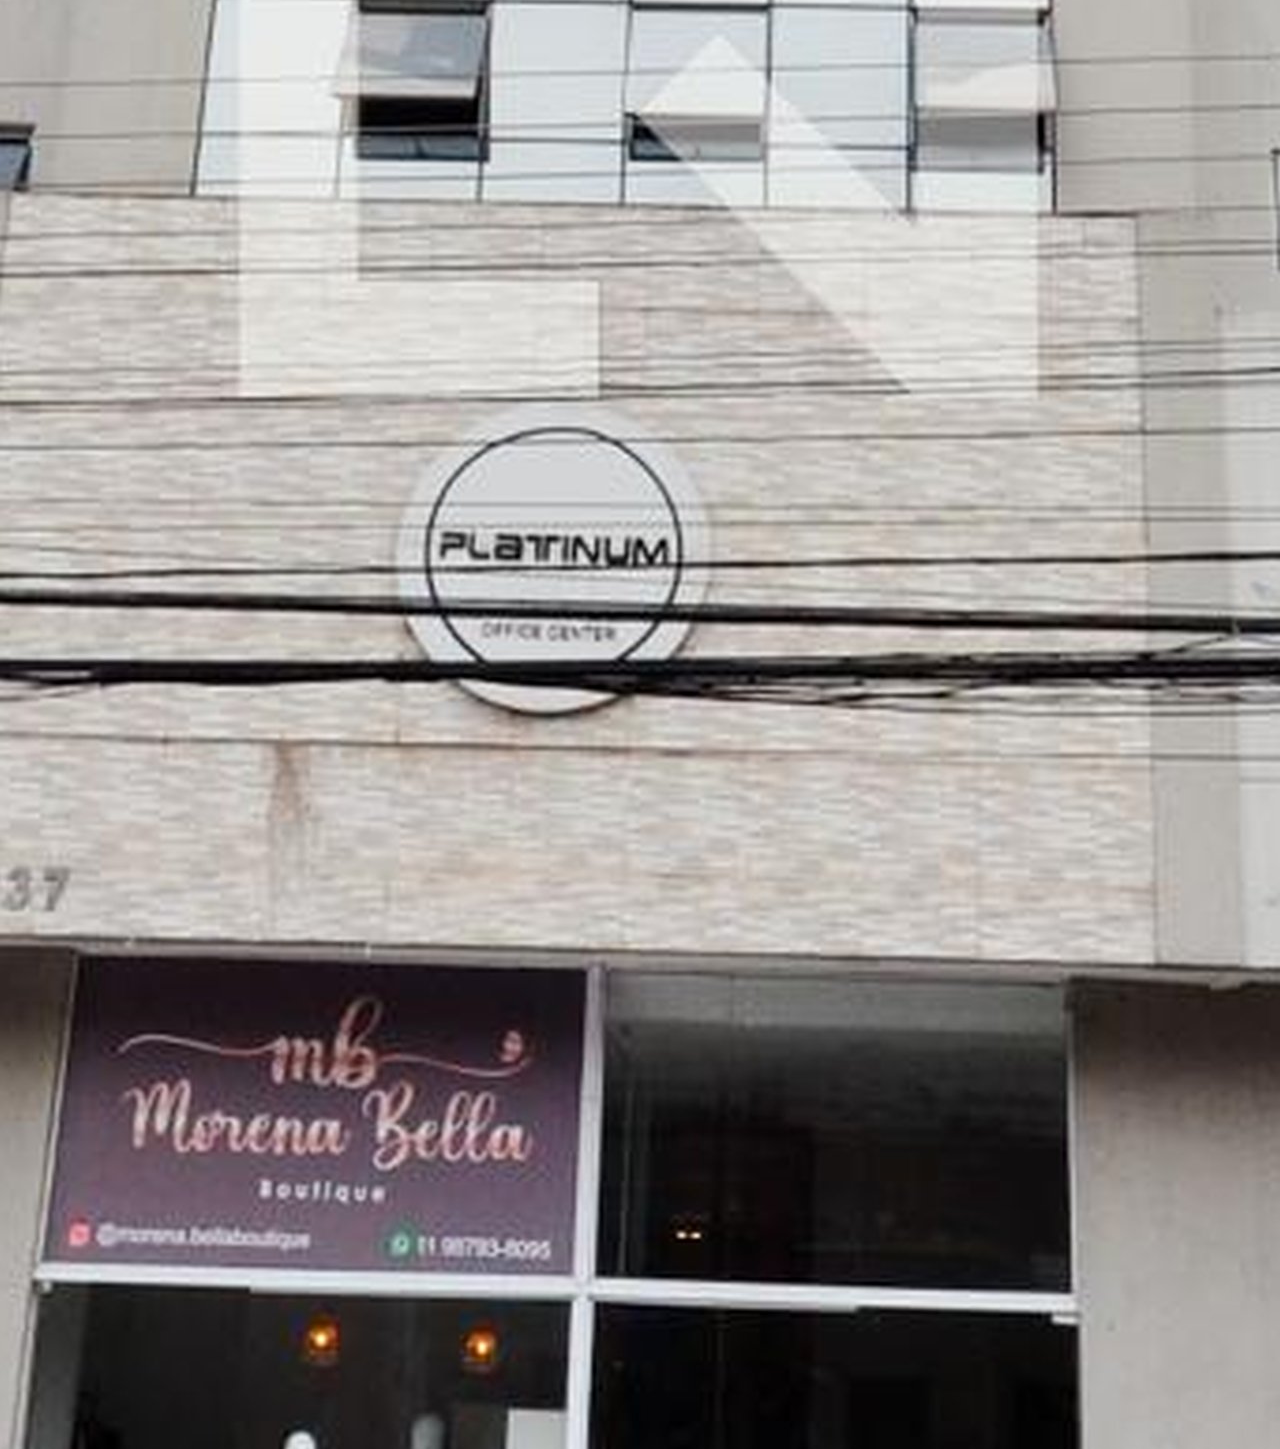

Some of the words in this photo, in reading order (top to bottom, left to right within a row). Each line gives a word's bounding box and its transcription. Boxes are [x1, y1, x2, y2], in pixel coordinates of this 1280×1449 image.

[439, 531, 669, 567] PLATINUM
[481, 620, 541, 641] OFFICE
[548, 622, 616, 642] CENTER
[124, 1078, 351, 1155] Morena
[361, 1082, 534, 1171] Bella
[259, 1179, 387, 1203] Boutique
